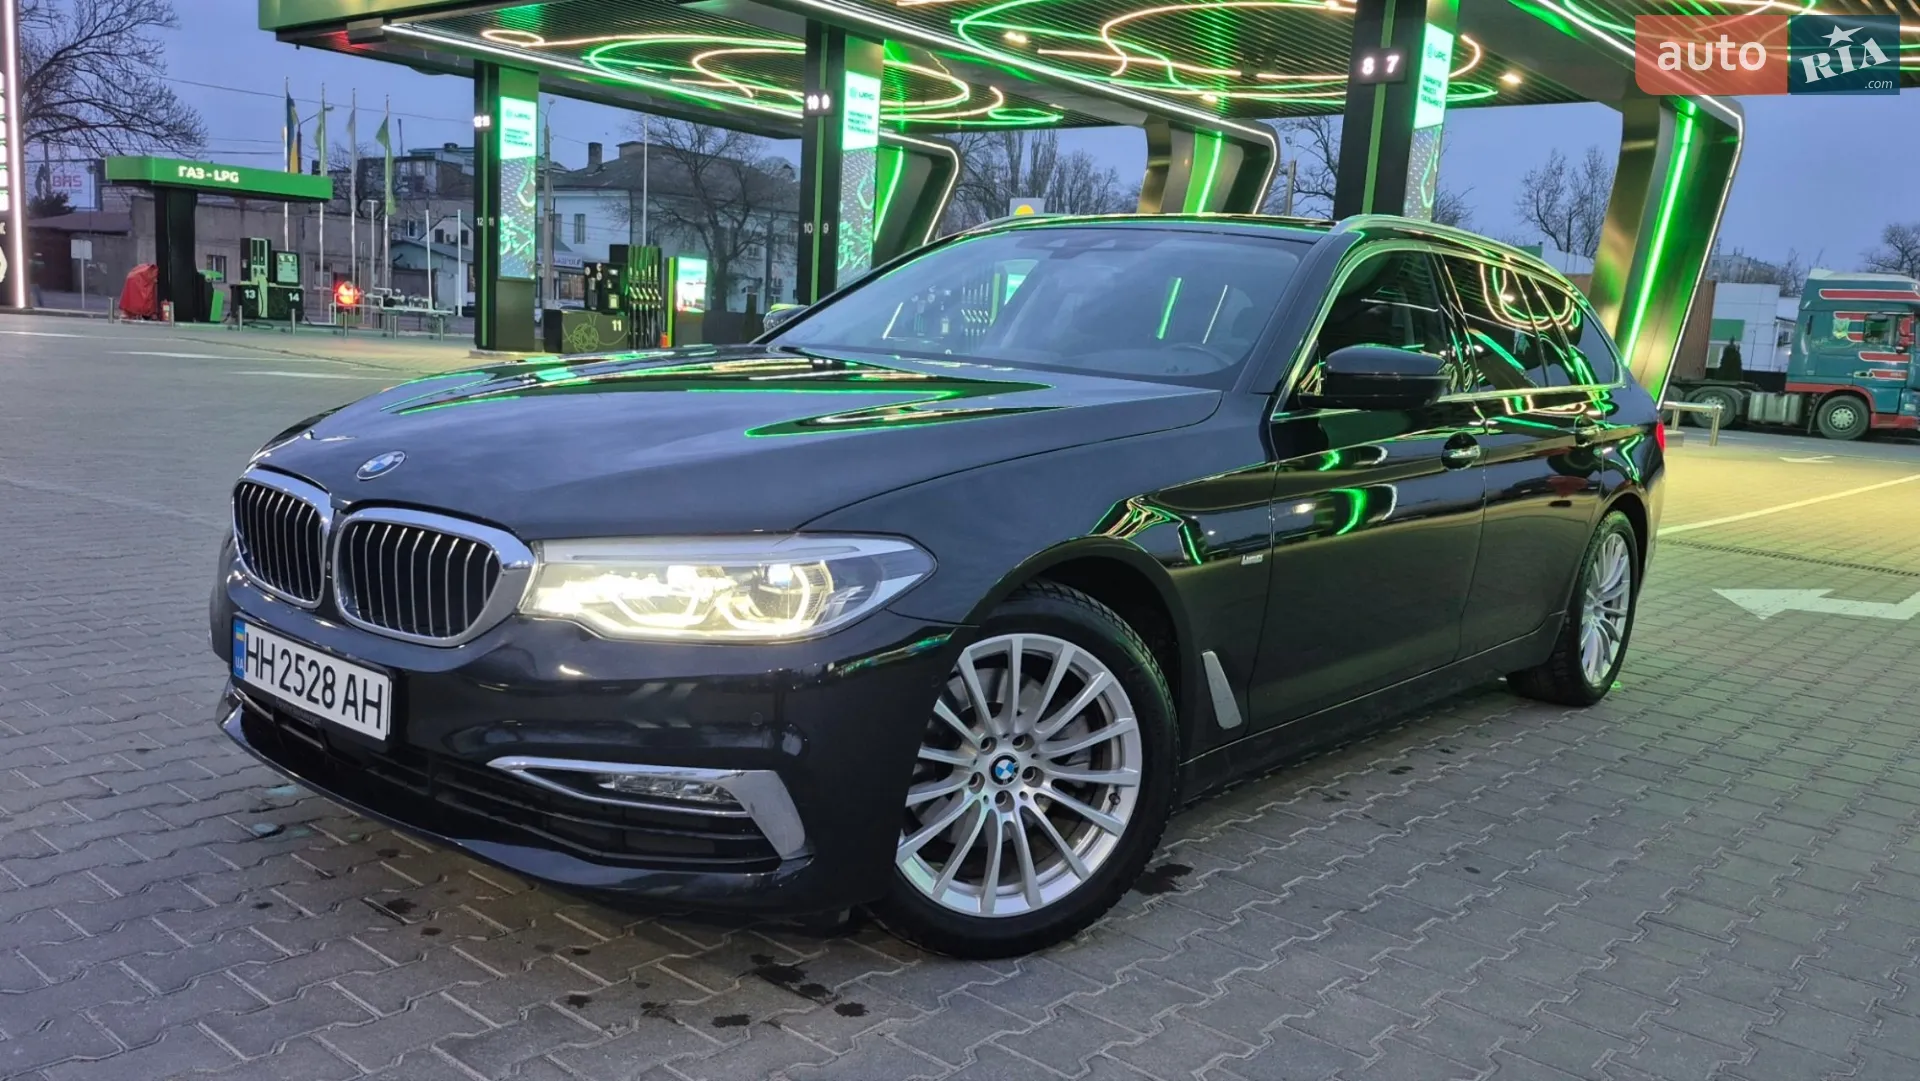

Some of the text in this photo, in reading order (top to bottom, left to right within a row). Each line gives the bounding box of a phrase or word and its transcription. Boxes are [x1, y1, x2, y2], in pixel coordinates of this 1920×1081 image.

[1361, 54, 1400, 75] 8 7
[803, 222, 829, 234] 10 9
[244, 289, 256, 299] 13
[288, 292, 300, 302] 14
[611, 319, 622, 331] 11
[235, 655, 244, 670] UA
[245, 632, 275, 685] HH
[279, 648, 336, 709] 2528
[341, 673, 383, 730] AH
